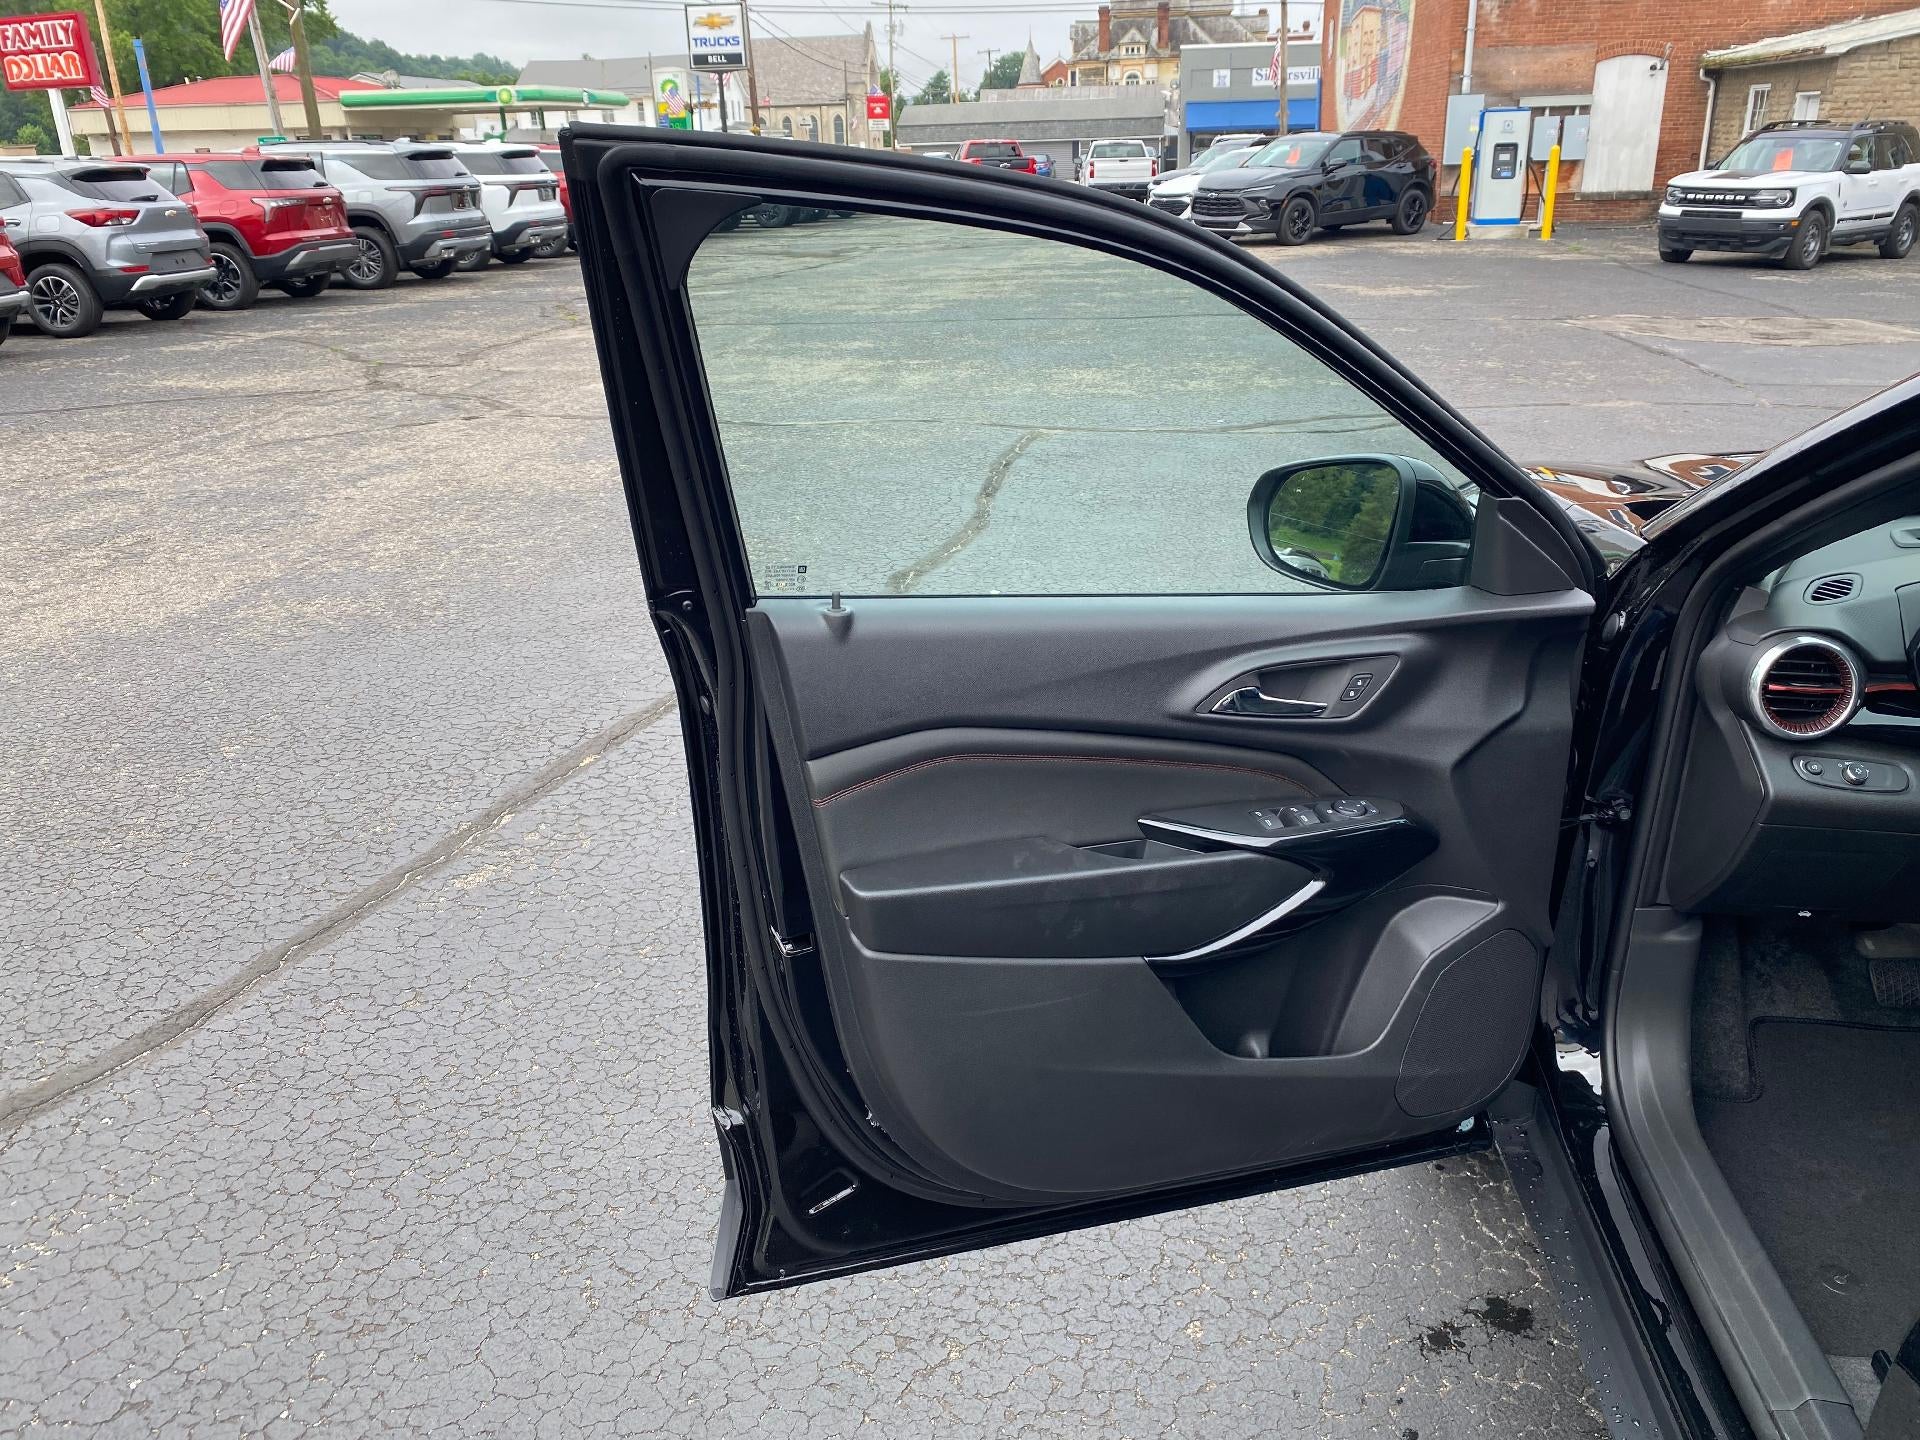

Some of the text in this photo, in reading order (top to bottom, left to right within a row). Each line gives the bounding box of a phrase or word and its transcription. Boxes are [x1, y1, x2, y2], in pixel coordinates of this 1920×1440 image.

[0, 20, 74, 51] FAMILY
[692, 36, 740, 47] TRUCKS
[4, 51, 84, 82] DOLLAR
[707, 55, 727, 63] BELL
[1255, 66, 1320, 81] Sirsvill
